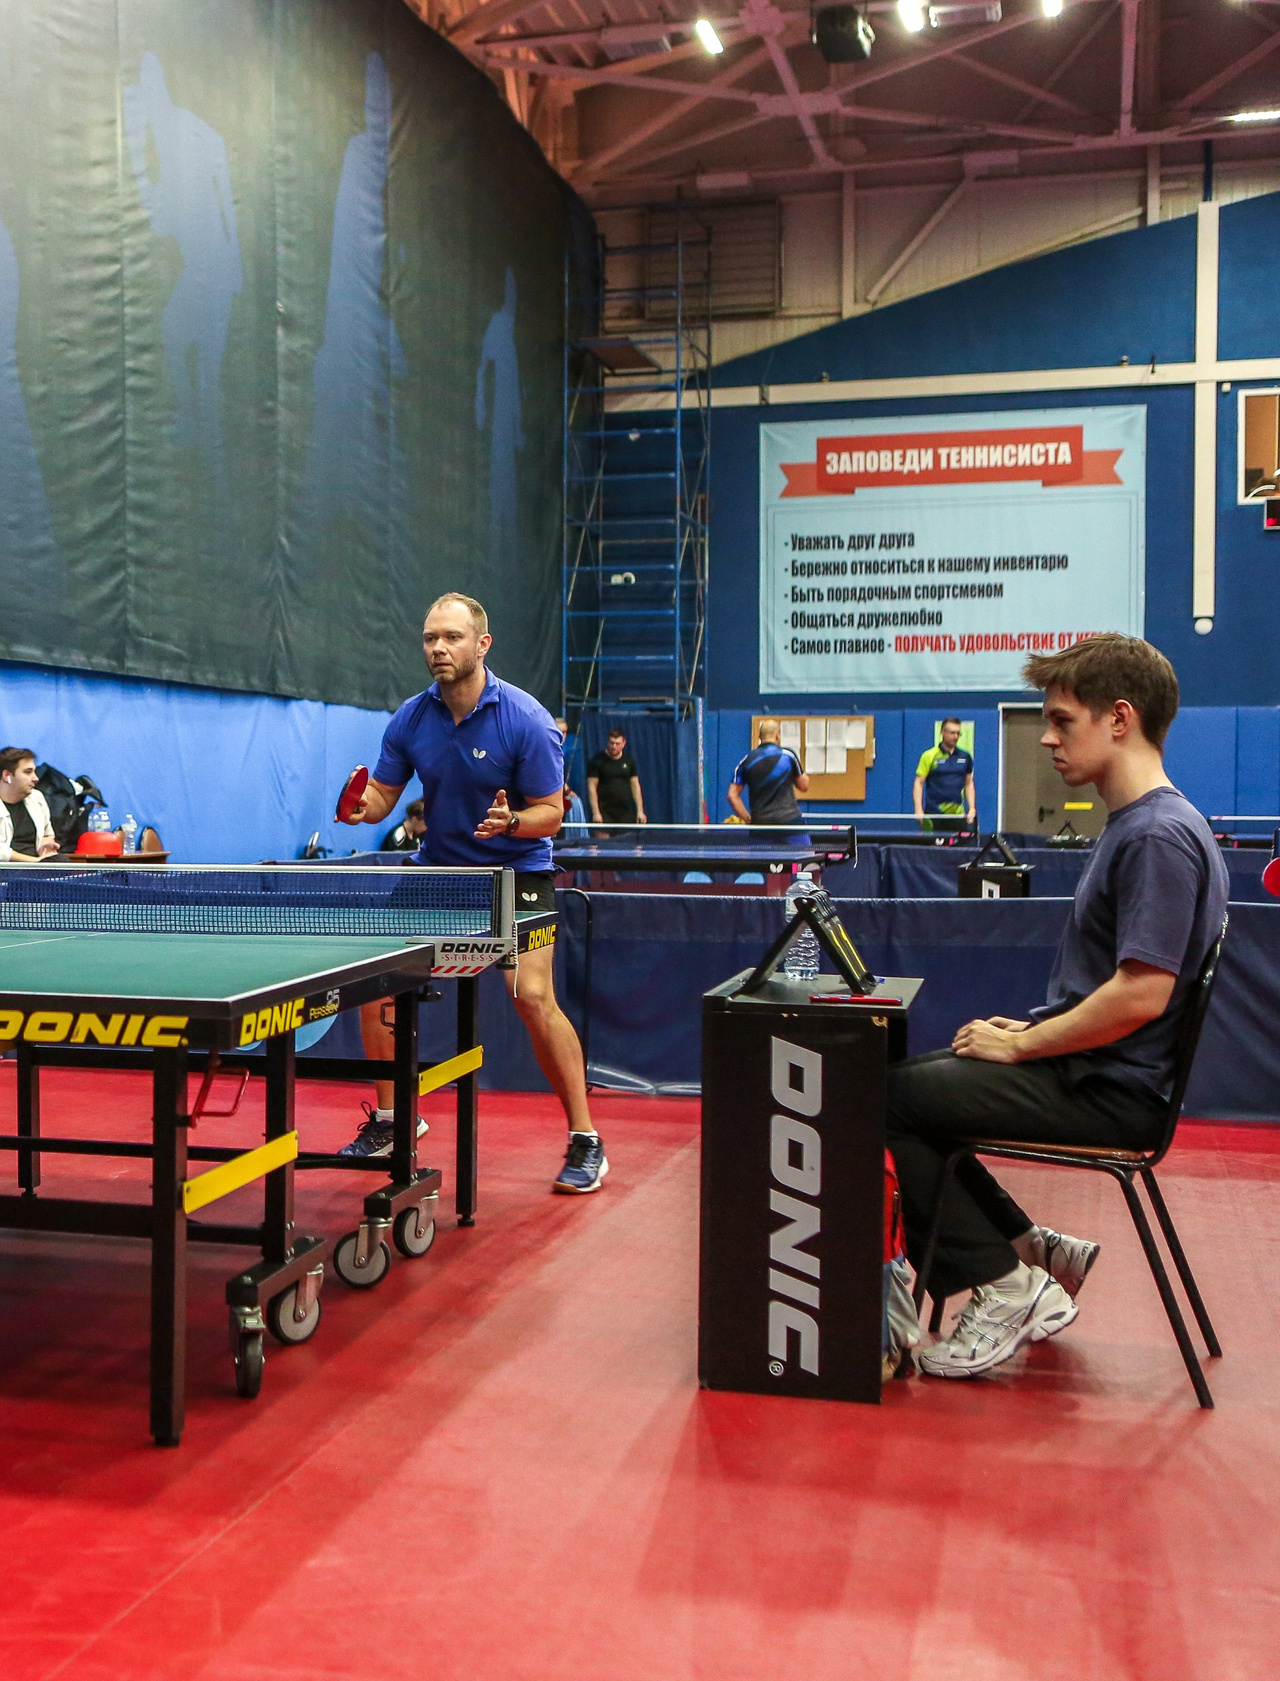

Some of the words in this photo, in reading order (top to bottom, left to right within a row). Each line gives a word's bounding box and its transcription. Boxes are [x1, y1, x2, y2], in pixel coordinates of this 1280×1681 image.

[825, 447, 934, 475] ЗАПОВЕДИ
[938, 441, 1072, 469] ТЕННИСИСТА
[791, 533, 844, 551] Уважать
[847, 533, 876, 551] друг
[878, 532, 915, 551] друга
[791, 559, 847, 578] Бережно
[850, 558, 925, 576] относиться
[927, 558, 935, 573] к
[937, 556, 991, 574] нашему
[993, 554, 1069, 573] инвентарю
[791, 585, 824, 604] Быть
[827, 584, 911, 604] порядочным
[914, 582, 1004, 602] спортсменом
[791, 610, 855, 631] Общаться
[857, 607, 943, 630] дружелюбно
[791, 637, 831, 655] Самое
[834, 637, 885, 654] главное
[894, 633, 956, 653] ПОЛУЧАТЬ
[959, 632, 1055, 654] УДОВОЛЬСТВИЕ
[1058, 632, 1073, 650] ОТ
[440, 943, 505, 953] DONIC
[528, 924, 557, 950] DONIC
[239, 998, 305, 1047] DONIC
